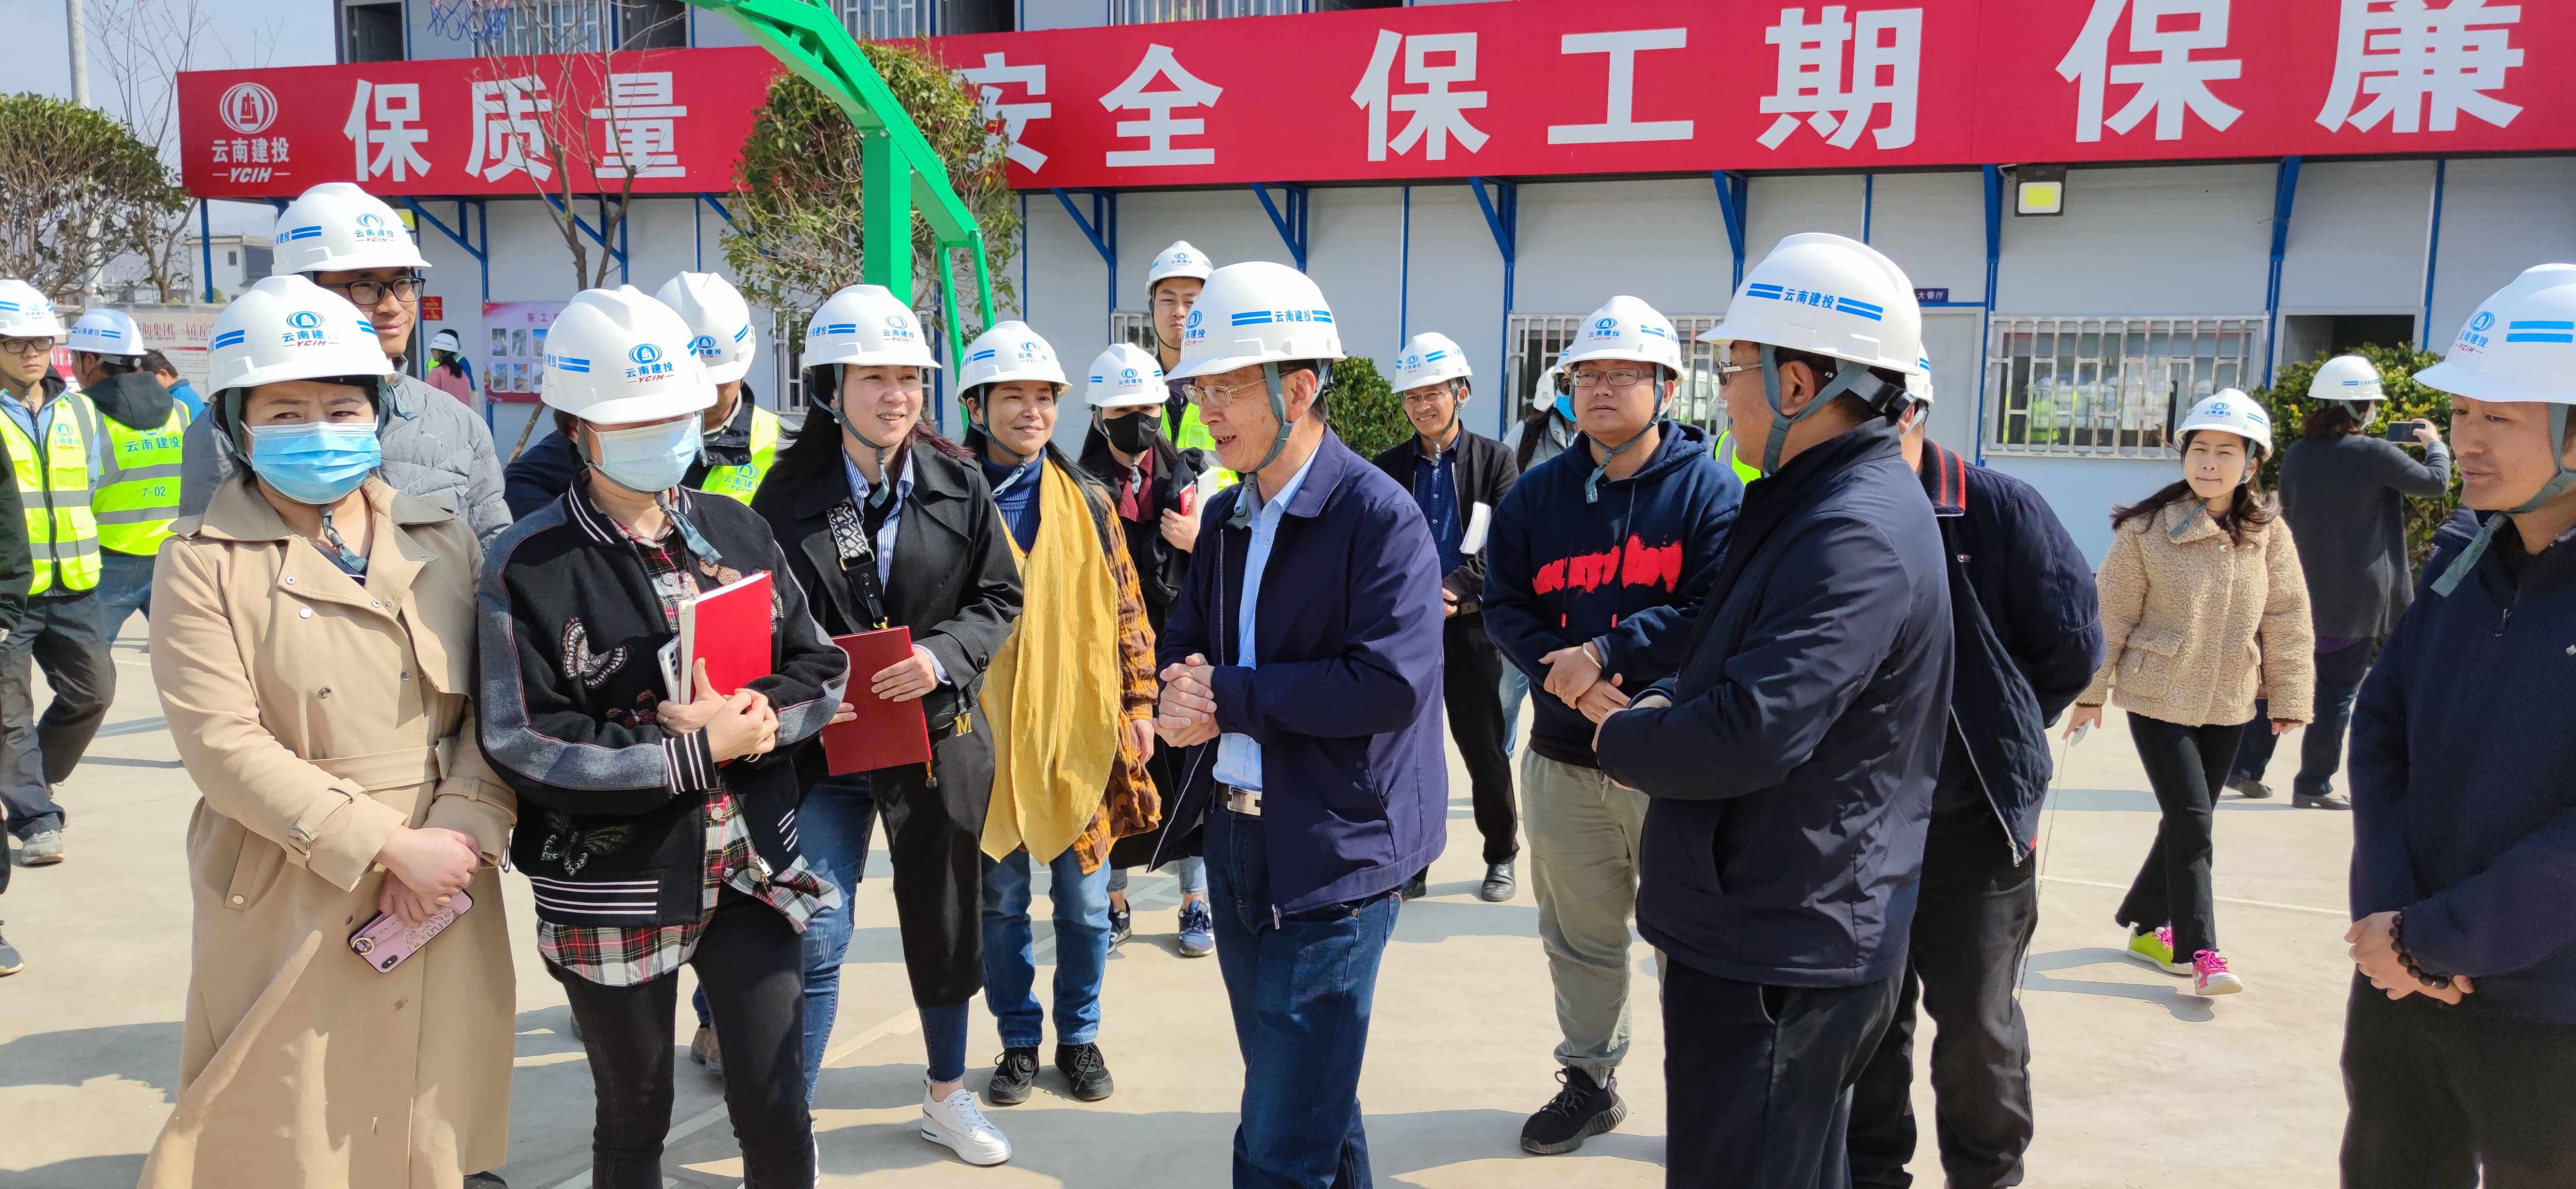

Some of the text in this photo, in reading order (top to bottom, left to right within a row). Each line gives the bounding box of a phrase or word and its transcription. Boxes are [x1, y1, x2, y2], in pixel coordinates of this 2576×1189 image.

[343, 0, 2524, 183] 保质量 安全 保工期 保廉
[211, 137, 289, 163] 云南建投
[230, 167, 272, 183] YCIH
[1784, 289, 1835, 309] 云南建投
[1275, 310, 1312, 322] 云南建投
[282, 330, 338, 343] 云南建
[883, 329, 914, 339] 云南建投
[1588, 330, 1621, 338] 云南建投
[2459, 331, 2488, 348] 云南建投
[2458, 343, 2476, 353] YCIH
[625, 362, 674, 378] 云南建投
[638, 374, 664, 383] YCIH
[124, 437, 181, 452] 云南建投
[143, 486, 166, 498] 7-02
